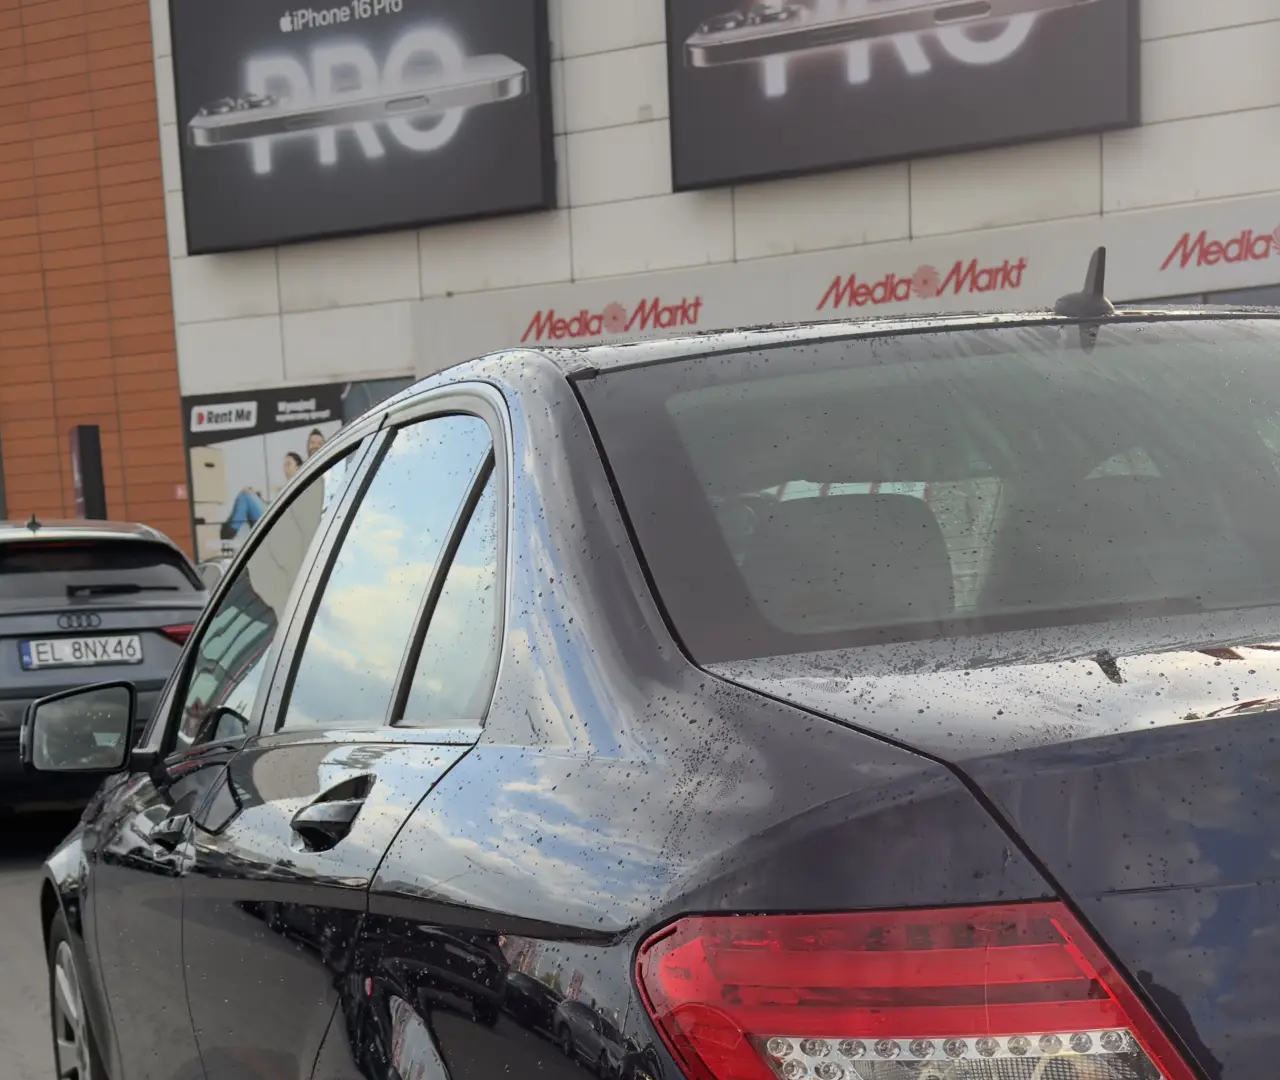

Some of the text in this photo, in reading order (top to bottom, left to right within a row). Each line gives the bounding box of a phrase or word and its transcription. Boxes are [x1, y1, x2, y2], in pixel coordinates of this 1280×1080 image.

[293, 0, 404, 31] iPhone 16 Pro
[1160, 229, 1273, 272] Media
[816, 256, 1028, 311] Media Markt
[520, 295, 704, 343] Media Markt
[206, 408, 253, 425] Rent Me
[35, 642, 63, 662] EL
[71, 638, 137, 660] 8NX46
